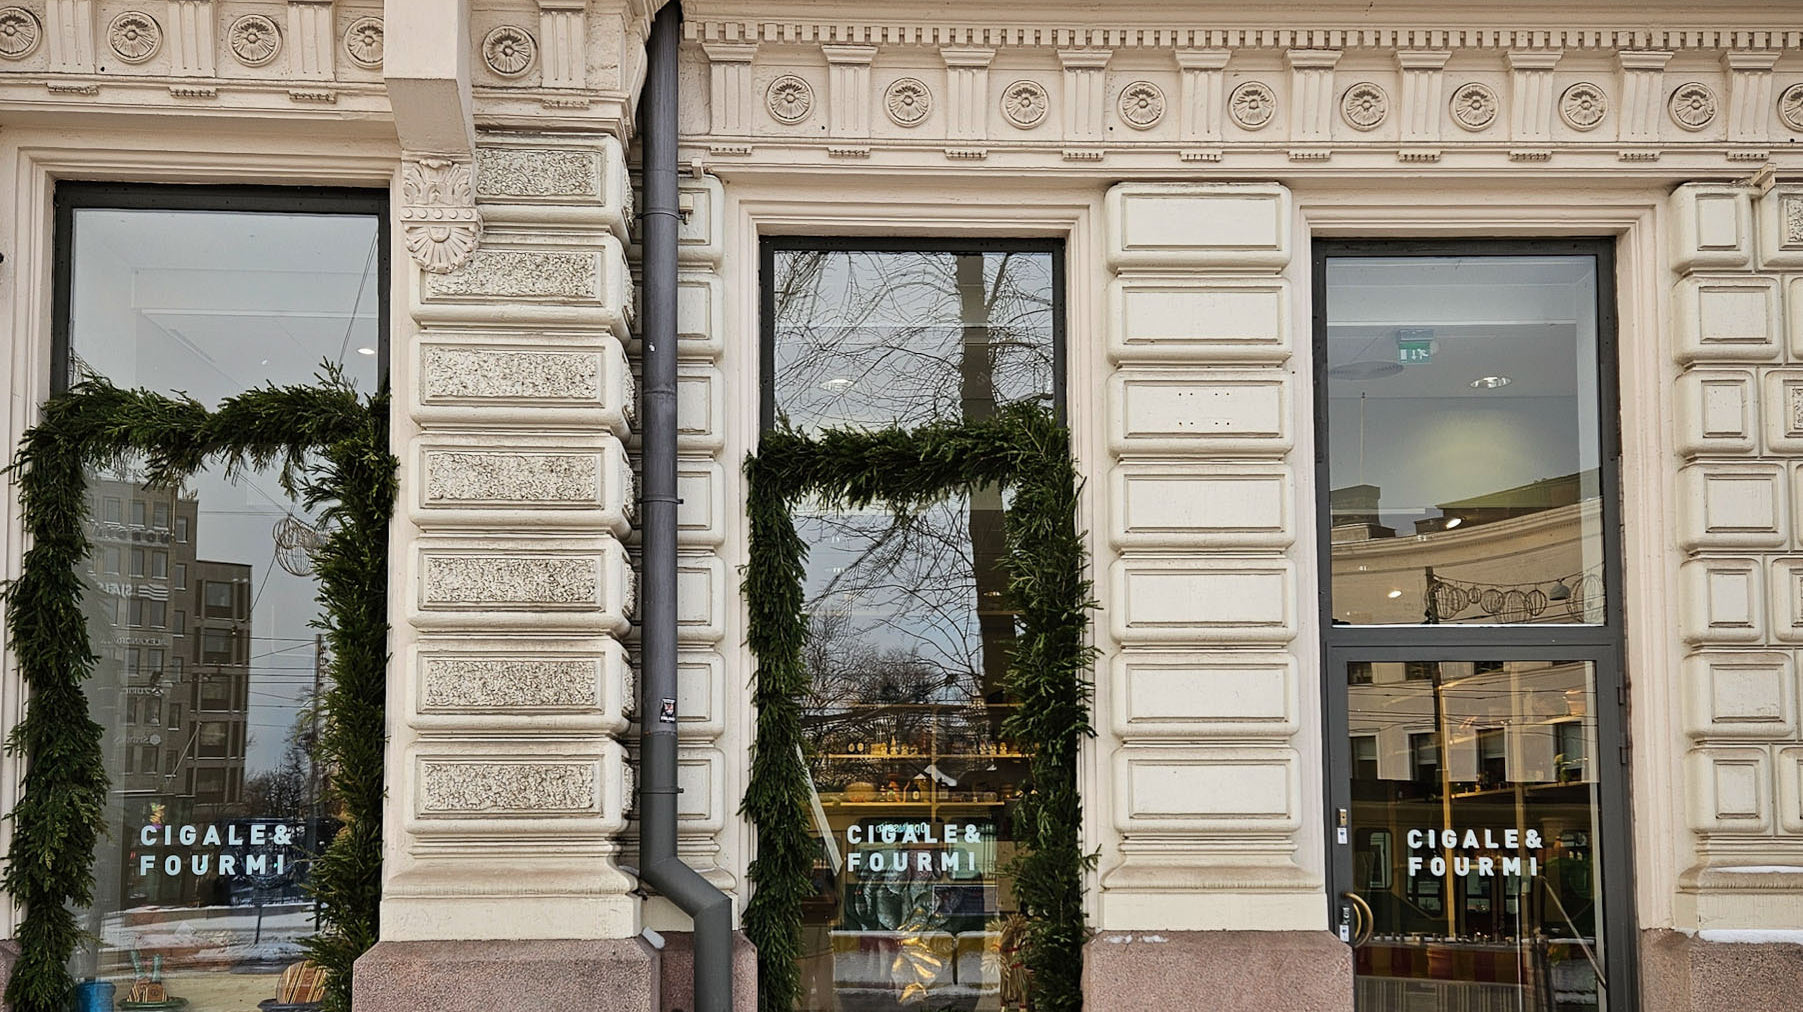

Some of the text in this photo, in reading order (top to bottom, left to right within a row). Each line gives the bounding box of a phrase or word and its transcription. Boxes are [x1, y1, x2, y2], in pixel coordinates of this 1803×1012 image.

[140, 824, 292, 846] CIGALE&
[847, 824, 981, 844] CIGALE&
[1407, 829, 1543, 849] CIGALE&
[140, 854, 284, 876] FOURMI
[847, 852, 975, 872] FOURMI
[1408, 857, 1538, 876] FOURMI
